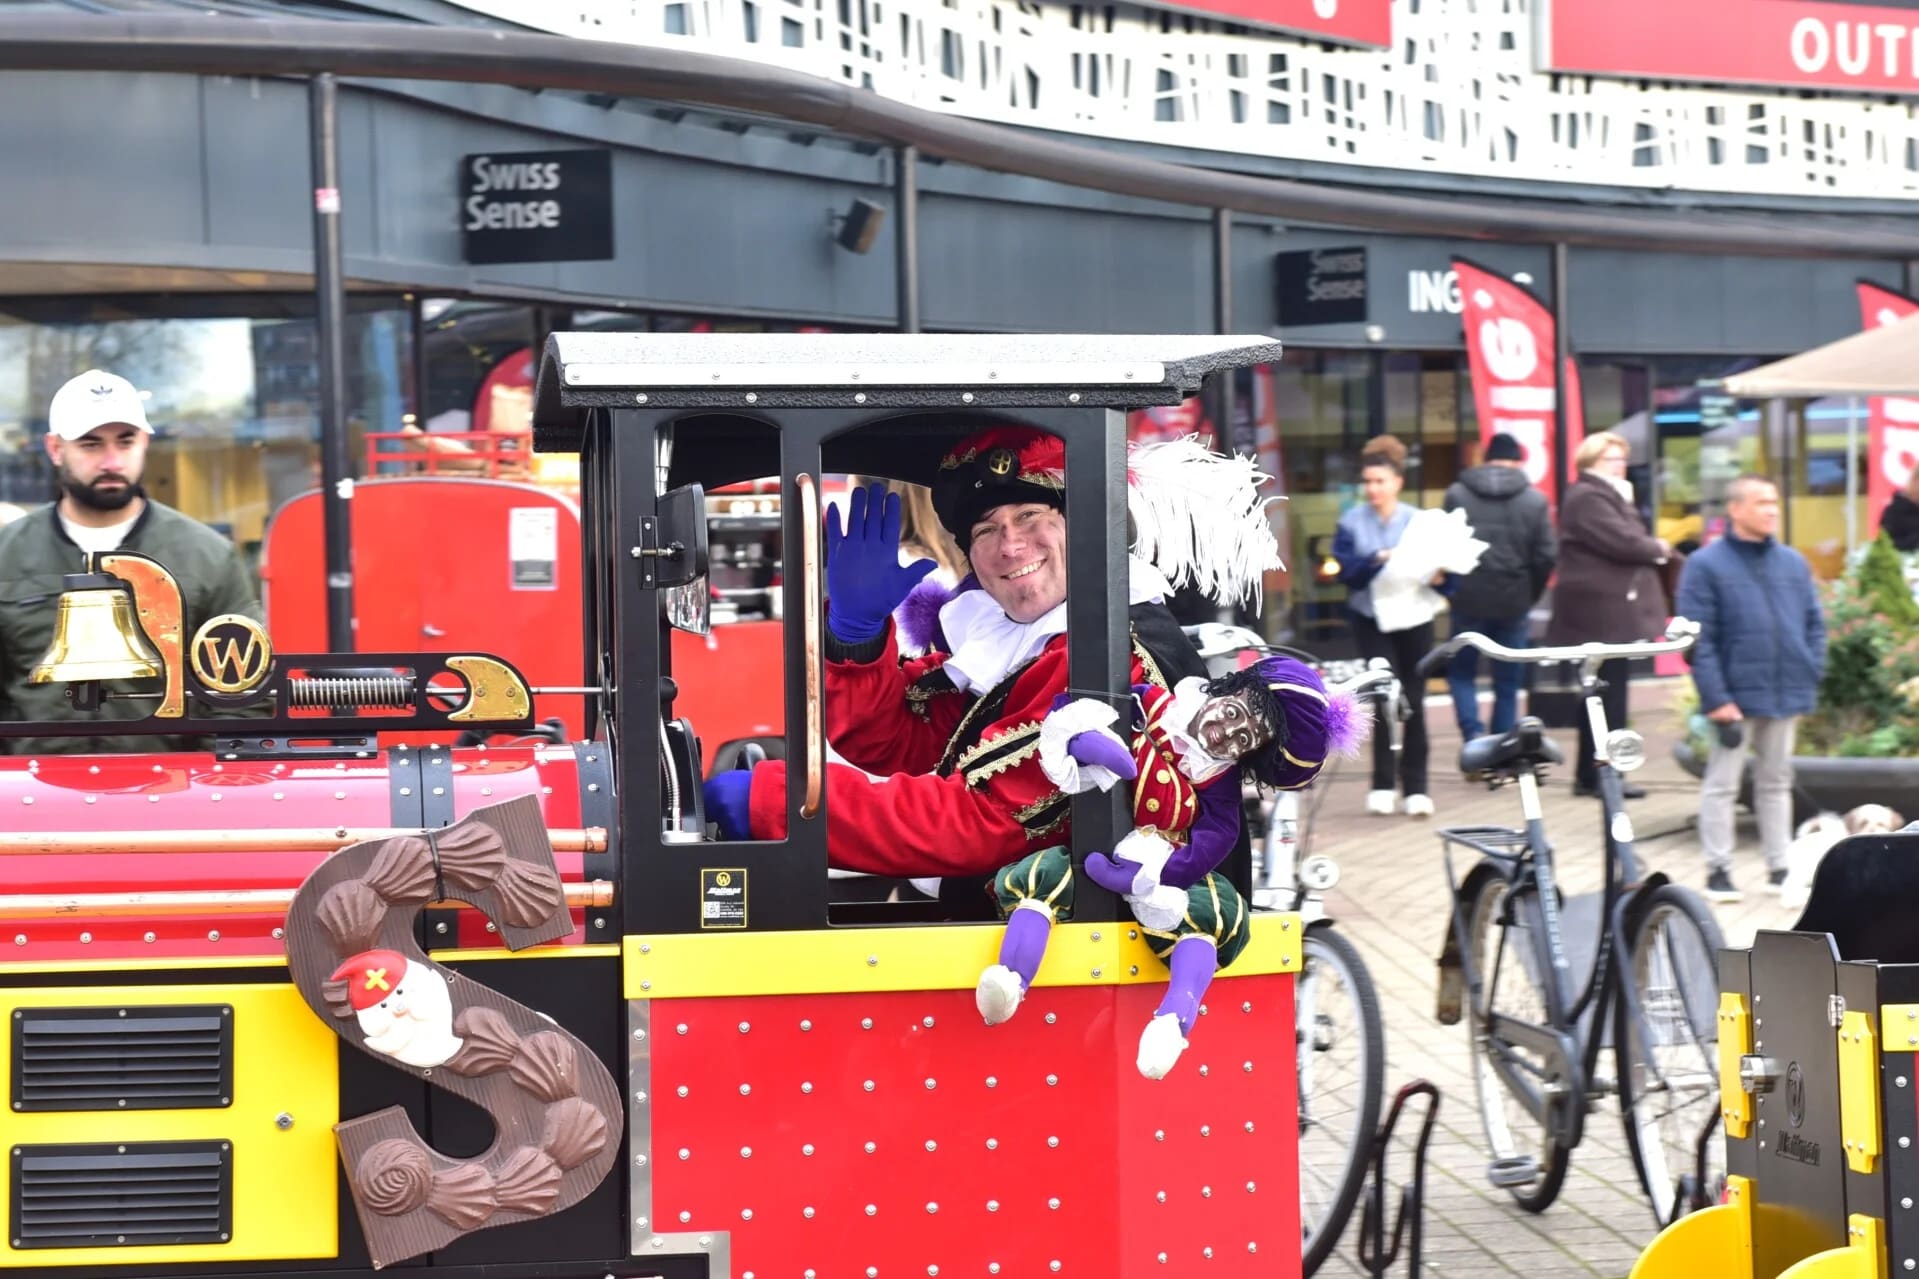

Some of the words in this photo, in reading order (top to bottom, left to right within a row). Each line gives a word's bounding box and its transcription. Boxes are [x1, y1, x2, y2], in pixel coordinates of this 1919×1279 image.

[472, 156, 560, 192] Swiss
[466, 194, 560, 231] Sense
[1307, 276, 1365, 302] Sense
[200, 625, 259, 687] W
